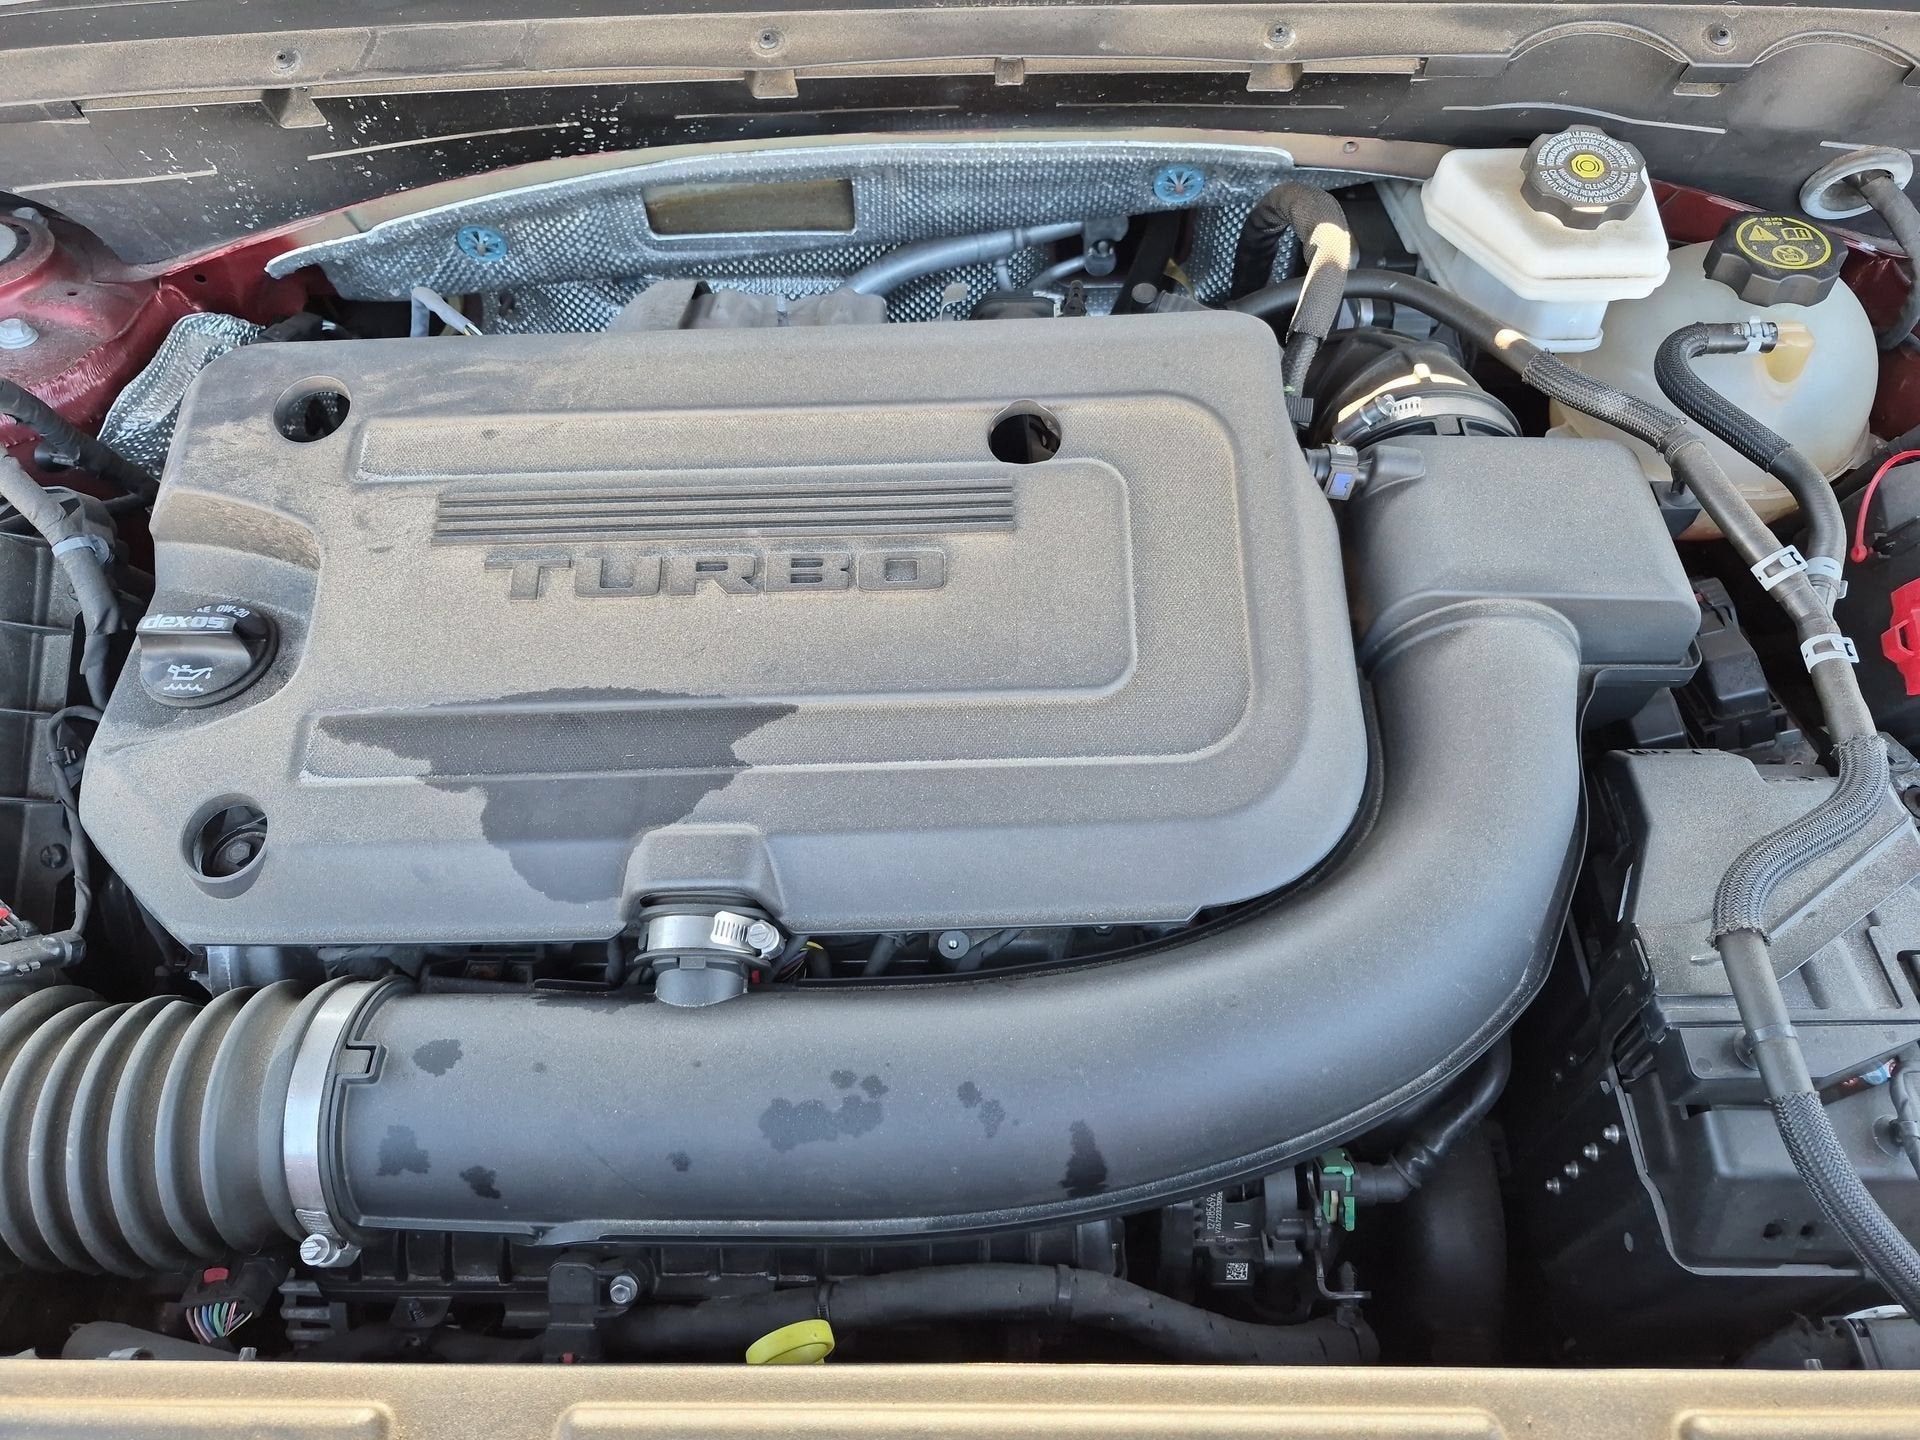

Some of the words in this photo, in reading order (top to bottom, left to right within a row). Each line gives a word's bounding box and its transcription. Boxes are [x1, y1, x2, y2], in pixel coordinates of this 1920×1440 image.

[1548, 169, 1560, 180] CAP
[1555, 178, 1579, 193] BEFORE
[1549, 182, 1569, 196] FLUID
[1566, 192, 1587, 202] FROM
[1593, 192, 1620, 203] SEALED
[1615, 171, 1638, 197] CONTAINER
[1584, 181, 1607, 189] CLEAN
[484, 546, 948, 600] TURBO
[143, 613, 225, 629] dexos
[216, 605, 250, 618] 0W-20
